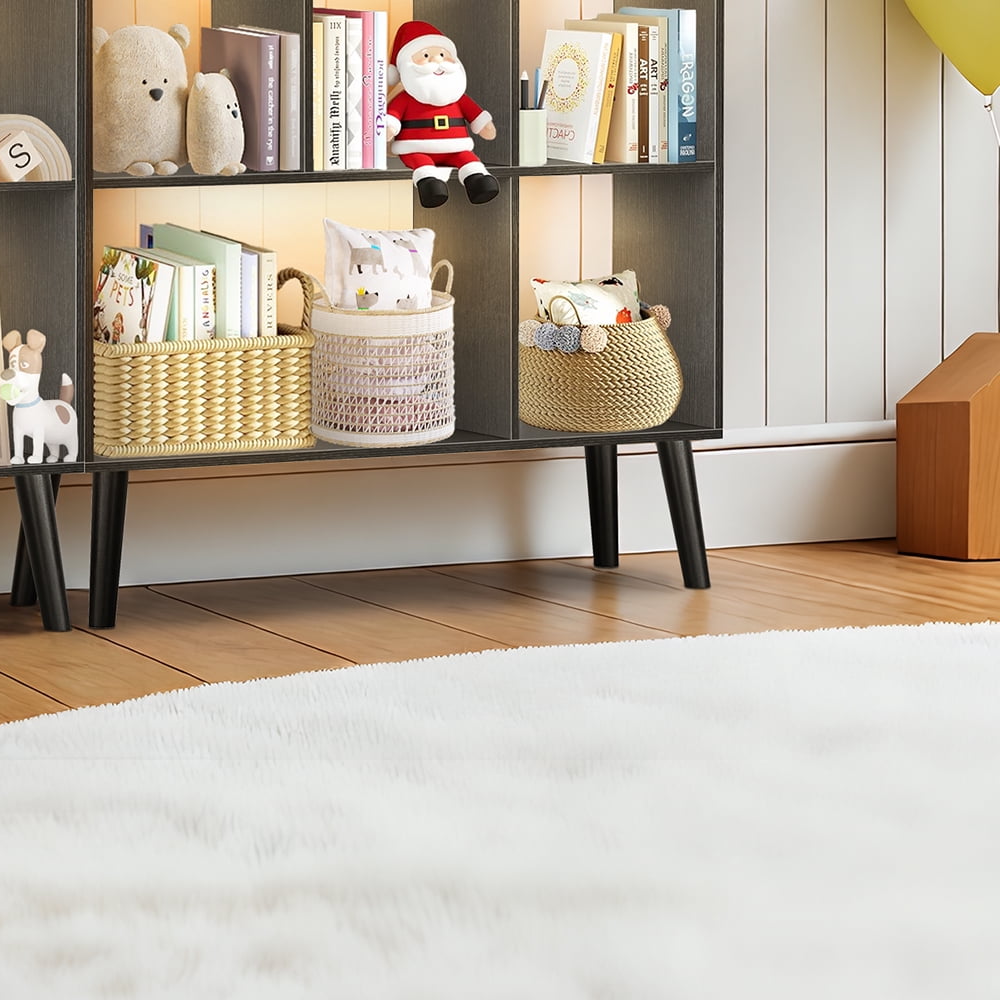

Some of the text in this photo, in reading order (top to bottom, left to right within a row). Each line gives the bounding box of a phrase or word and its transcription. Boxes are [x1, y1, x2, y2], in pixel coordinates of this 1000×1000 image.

[639, 59, 649, 80] ART
[650, 59, 659, 80] ART
[267, 77, 275, 89] the
[267, 90, 275, 116] catcher
[267, 126, 275, 137] the
[266, 139, 274, 151] rye
[109, 280, 135, 306] PETS
